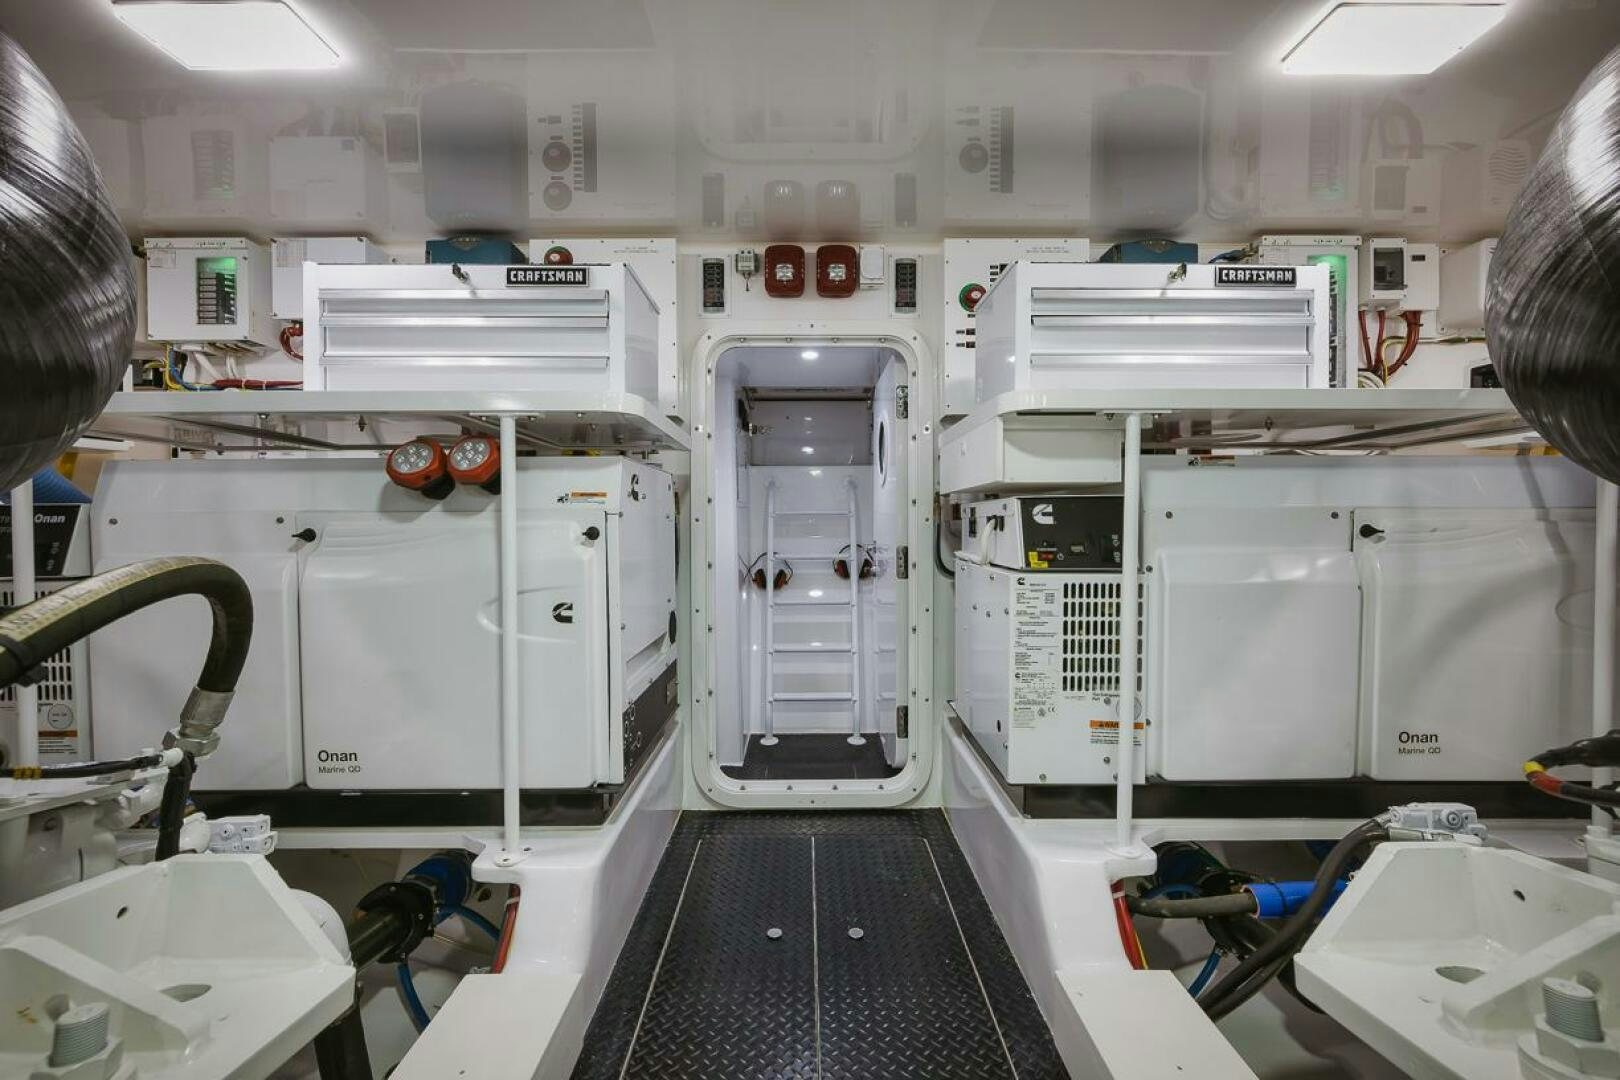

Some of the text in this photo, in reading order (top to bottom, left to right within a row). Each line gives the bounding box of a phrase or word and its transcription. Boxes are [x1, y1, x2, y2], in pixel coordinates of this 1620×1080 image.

[509, 269, 583, 282] CRAFTSMAN
[1221, 269, 1293, 282] CRAFTSMAN
[34, 513, 66, 523] Onan
[1398, 731, 1438, 744] Onan
[318, 749, 358, 762] Onan
[1398, 747, 1425, 755] Marine
[318, 765, 346, 774] Marine
